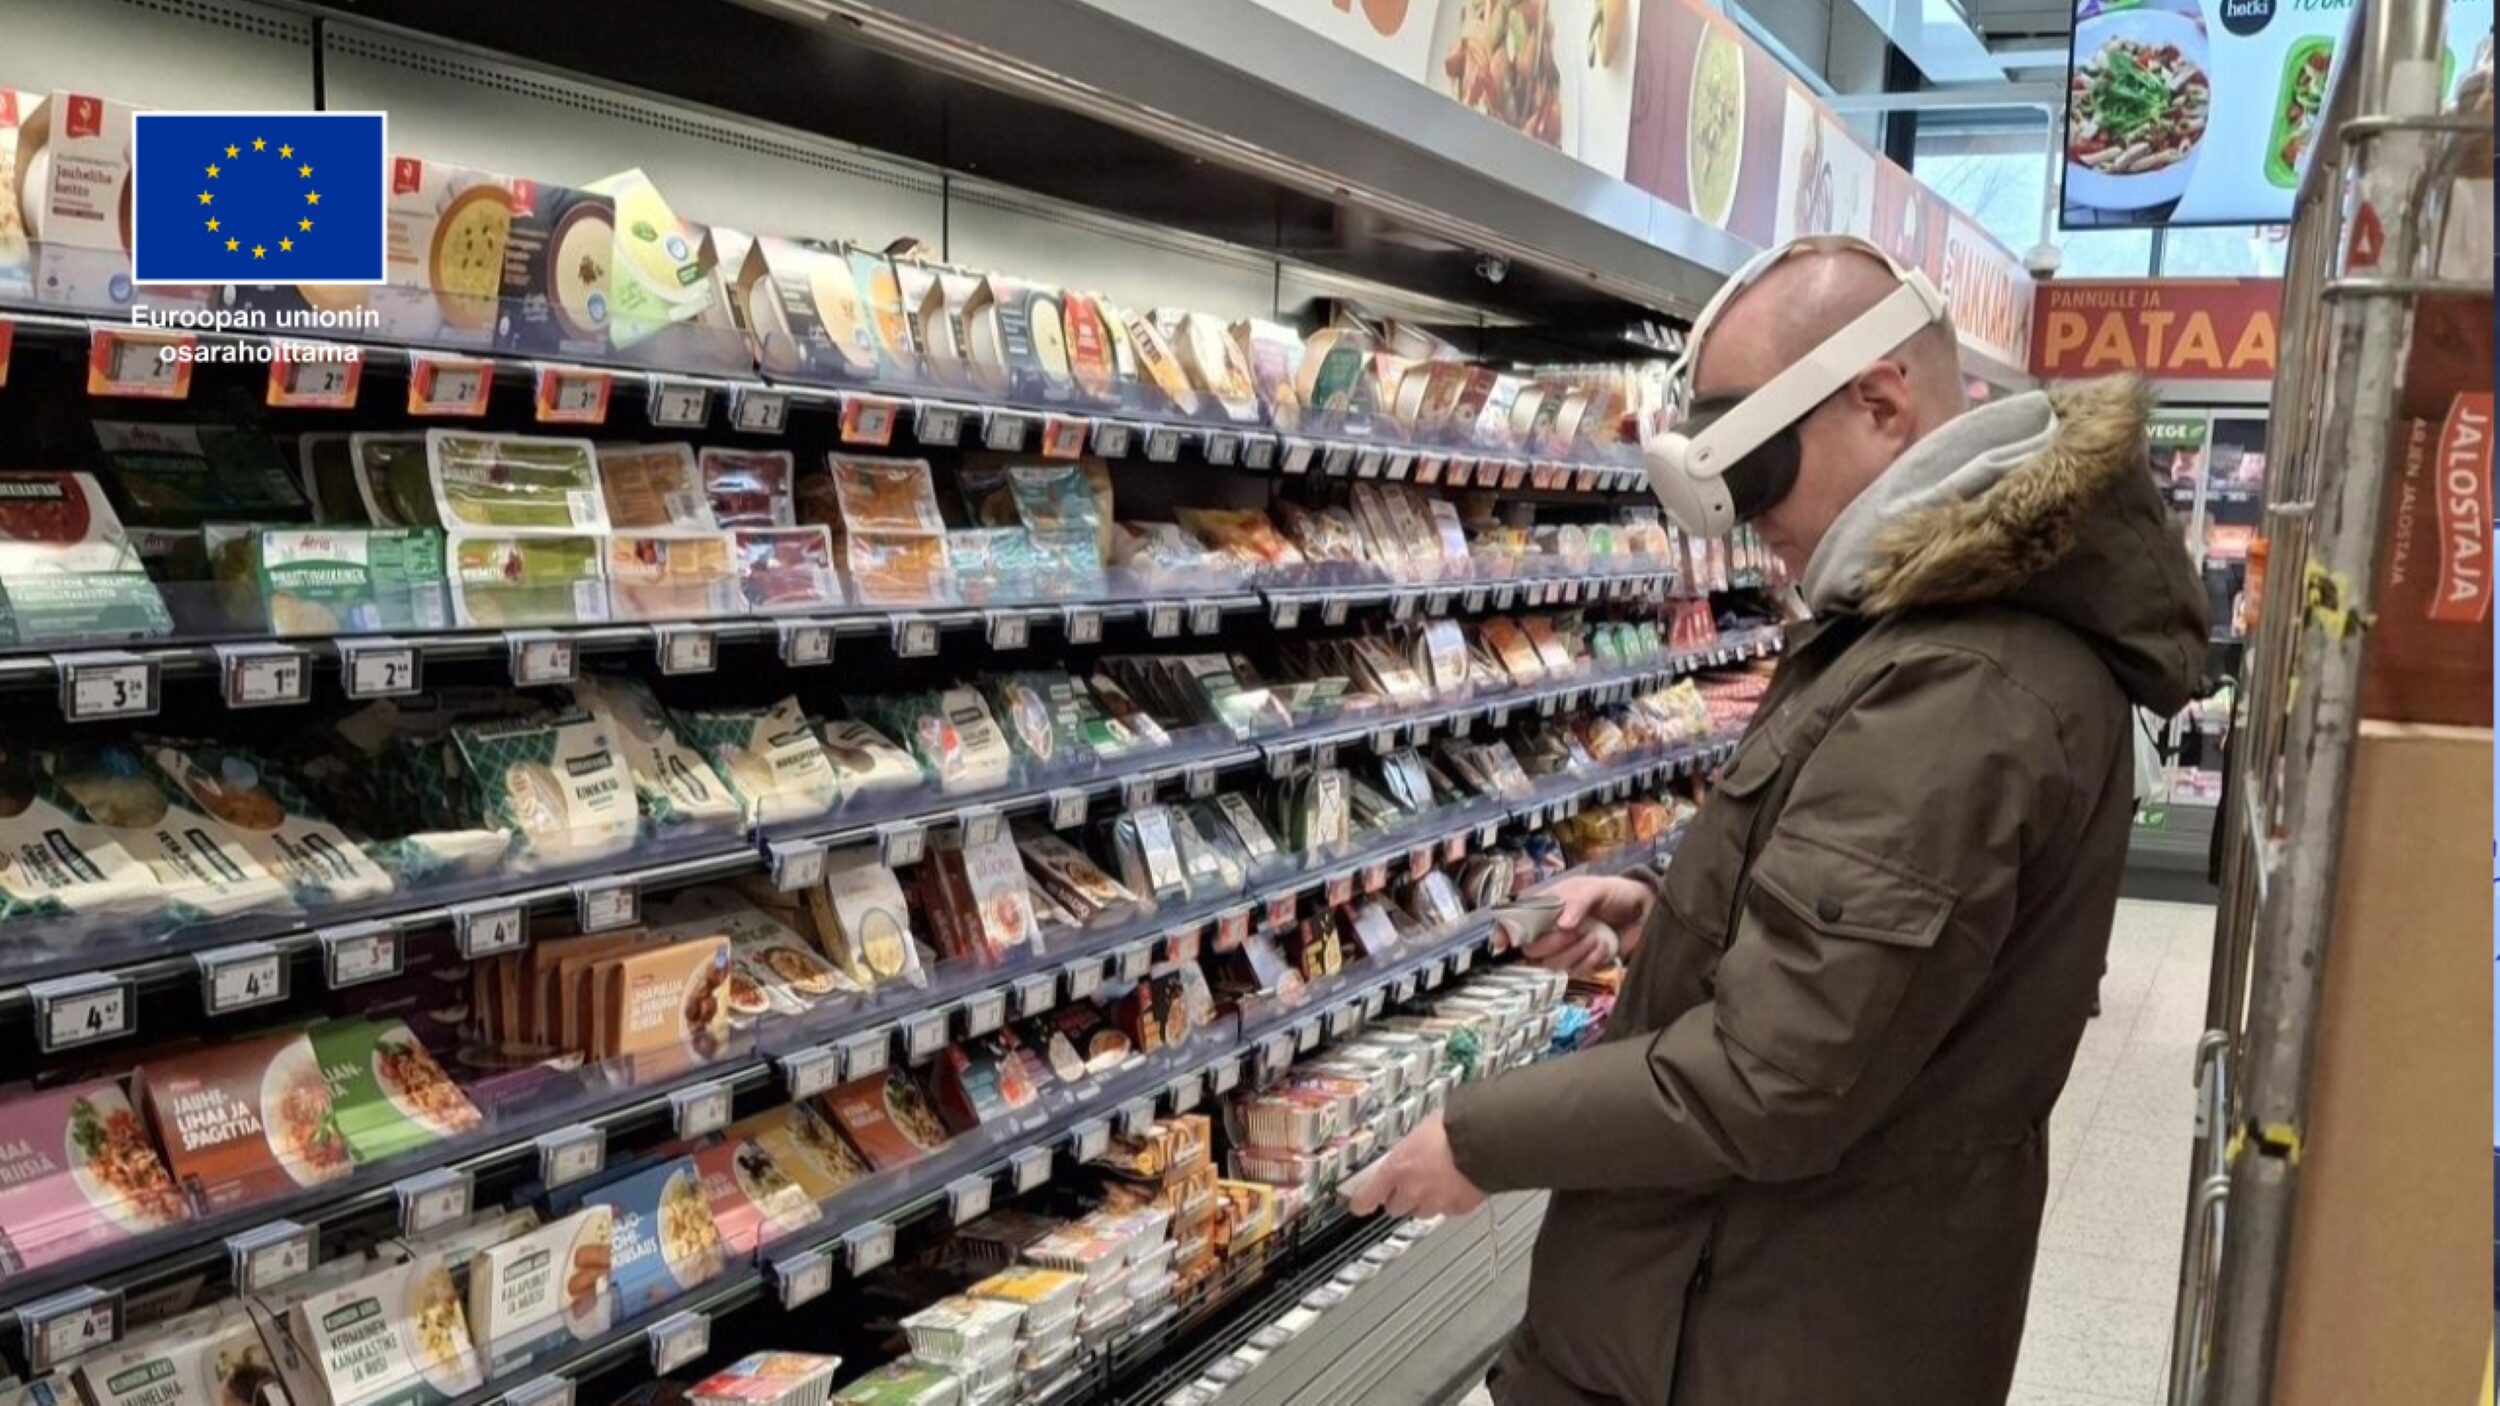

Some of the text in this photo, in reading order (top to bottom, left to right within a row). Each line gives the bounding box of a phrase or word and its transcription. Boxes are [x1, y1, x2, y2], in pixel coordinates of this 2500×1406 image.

[2051, 290, 2160, 308] PANNULLE JA
[2145, 424, 2187, 438] VEGE
[2406, 416, 2427, 477] ARJEN
[2448, 408, 2488, 602] JALOSTAJA
[177, 1100, 251, 1135] LIHAA JA
